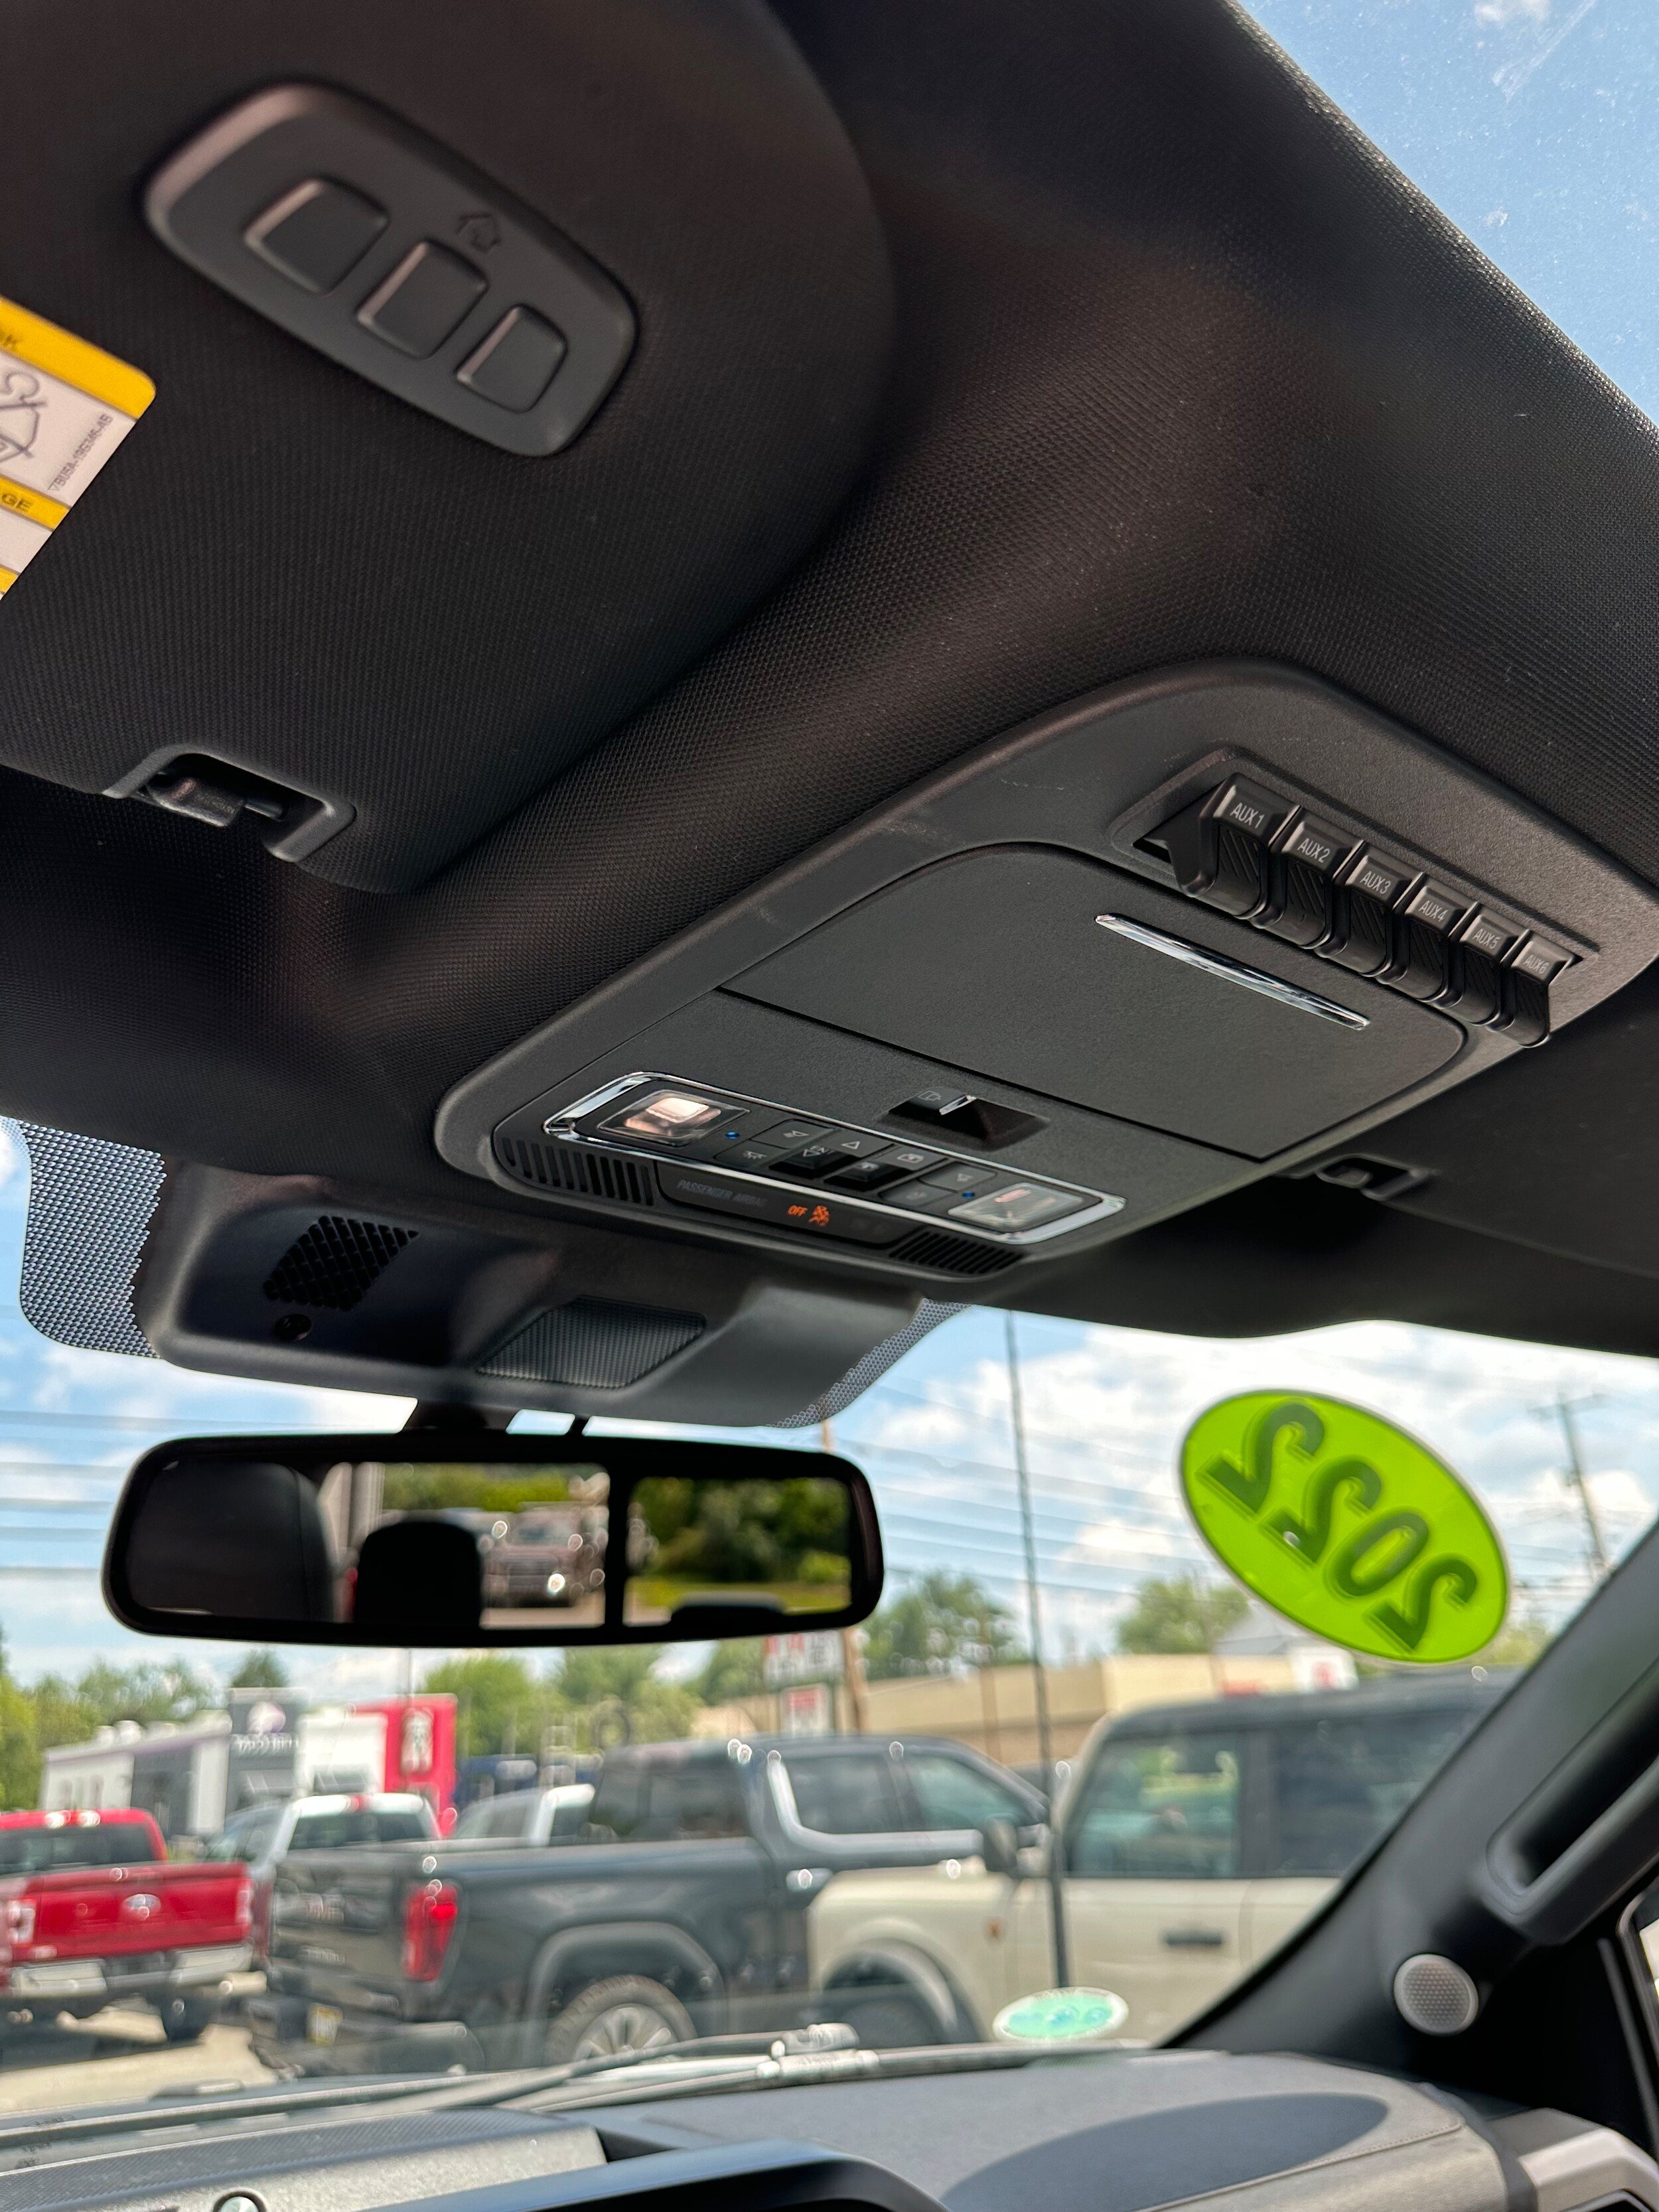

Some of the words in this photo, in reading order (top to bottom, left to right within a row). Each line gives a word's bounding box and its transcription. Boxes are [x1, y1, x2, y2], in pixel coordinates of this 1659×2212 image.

[1230, 802, 1265, 828] AUX1
[1297, 838, 1330, 863] AUX2
[1360, 871, 1391, 895] AUX3
[1419, 900, 1448, 922] AUX4
[1473, 928, 1500, 949] AUX5
[1522, 954, 1550, 974] AUX6
[677, 1179, 733, 1200] PASSENGER
[787, 1205, 808, 1218] OFF
